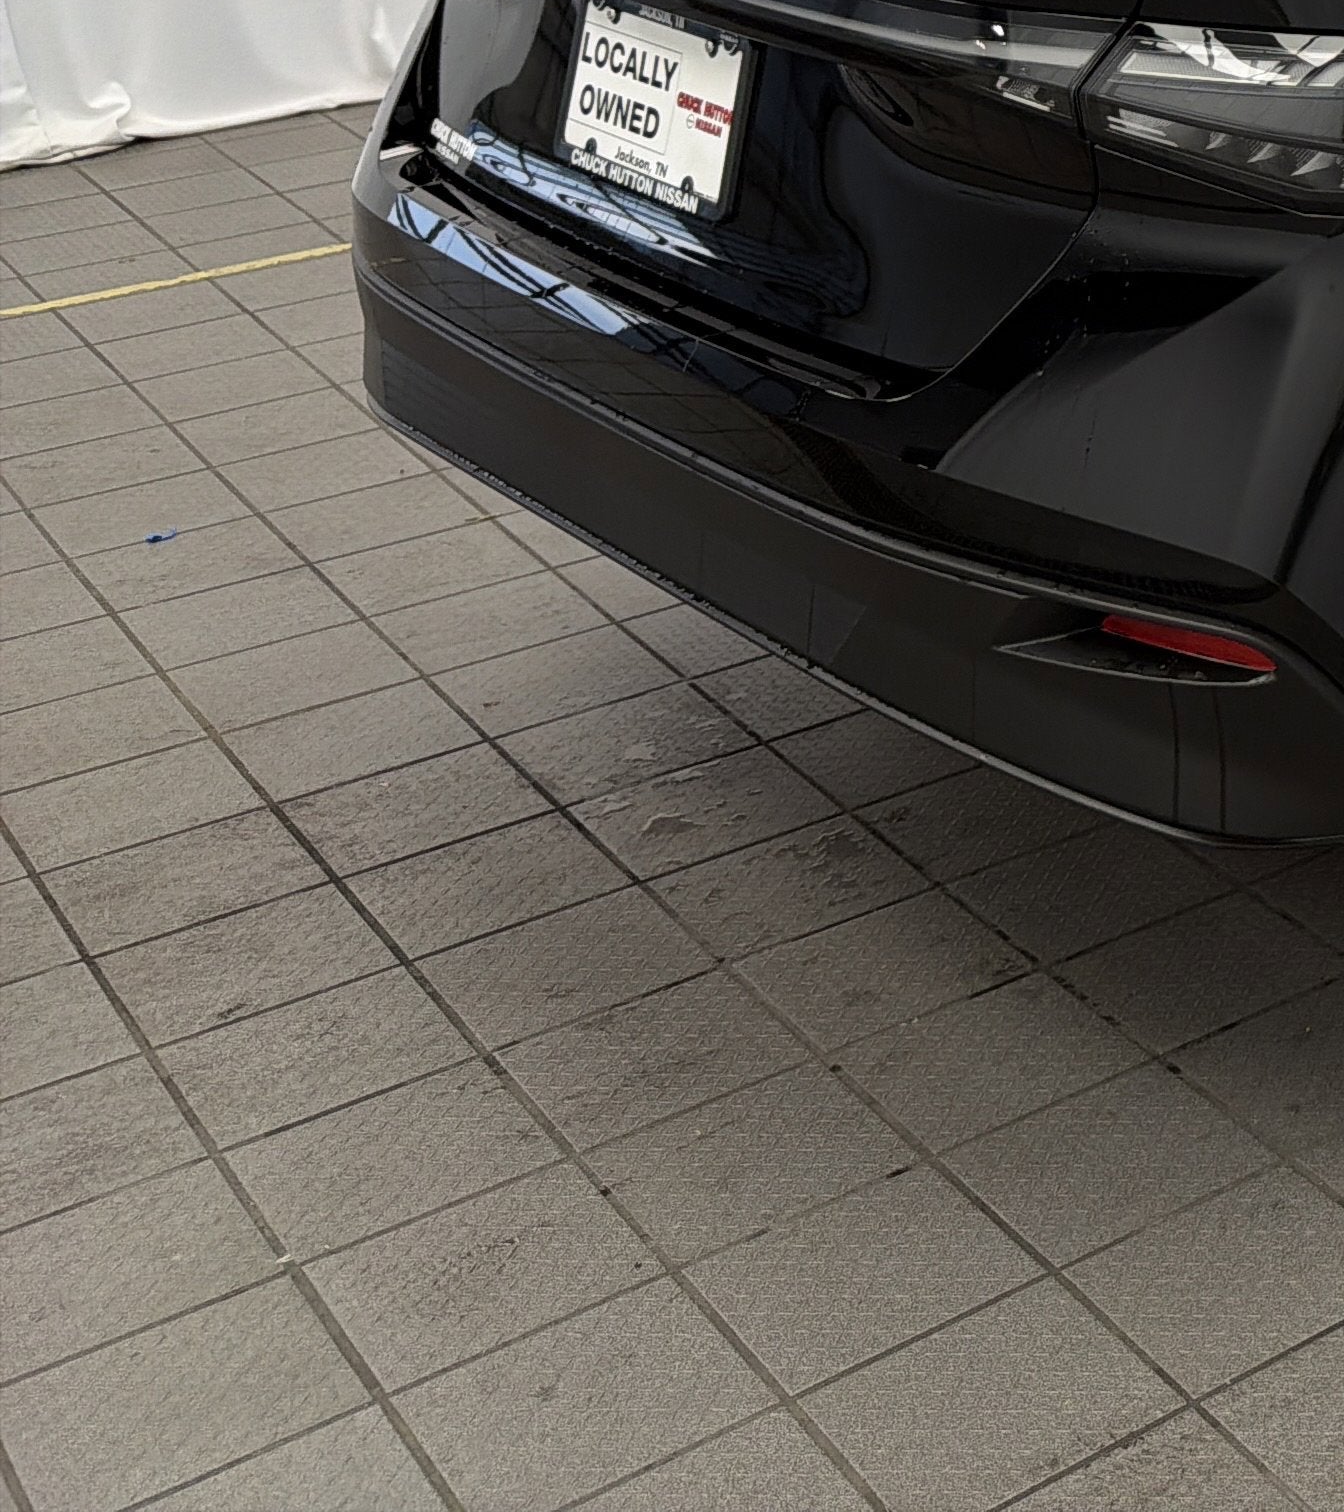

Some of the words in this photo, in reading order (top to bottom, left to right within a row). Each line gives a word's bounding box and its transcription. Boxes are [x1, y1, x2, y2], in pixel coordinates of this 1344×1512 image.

[581, 31, 679, 92] LOCALLY
[579, 84, 660, 139] OWNED
[571, 148, 608, 178] CHUCK
[607, 163, 655, 197] HUTTON
[653, 182, 700, 215] NISSAN
[614, 145, 652, 174] Jackson,
[654, 160, 669, 179] TN
